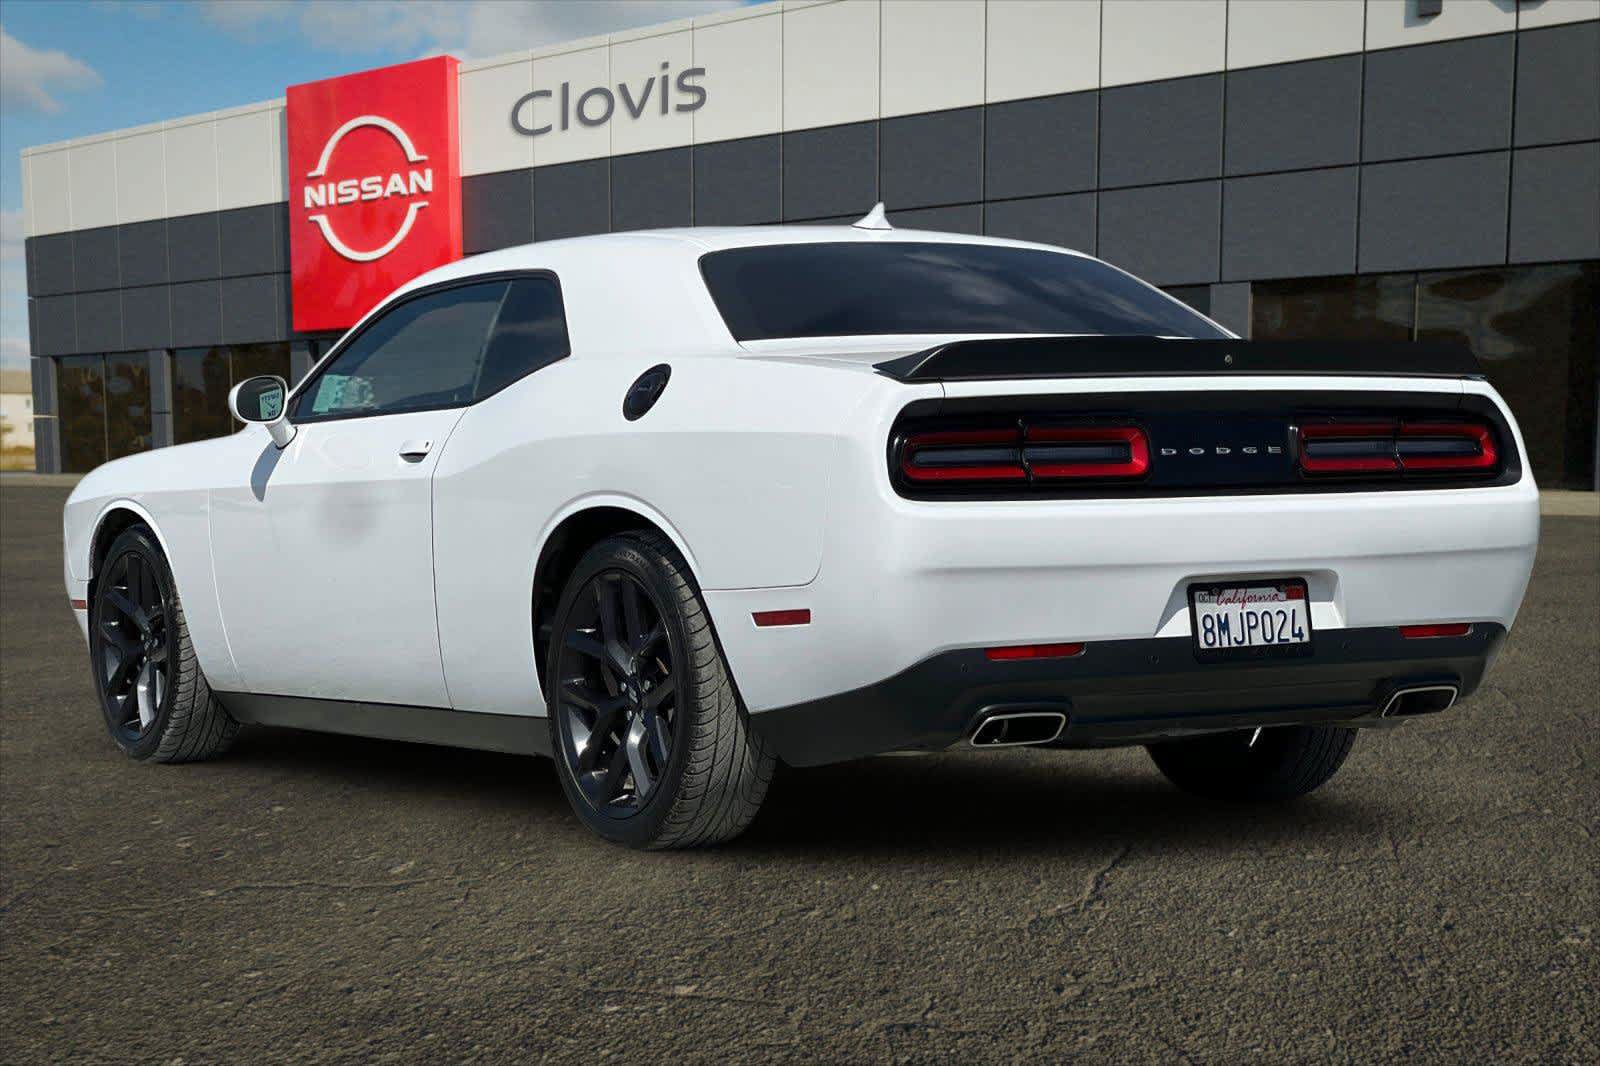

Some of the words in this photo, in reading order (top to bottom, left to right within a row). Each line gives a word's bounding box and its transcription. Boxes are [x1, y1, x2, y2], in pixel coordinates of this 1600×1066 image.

[511, 62, 707, 136] Clovis
[304, 168, 433, 208] NISSAN
[1161, 446, 1281, 455] DODGE
[1215, 588, 1284, 609] California
[1202, 608, 1304, 647] 8MJP024
